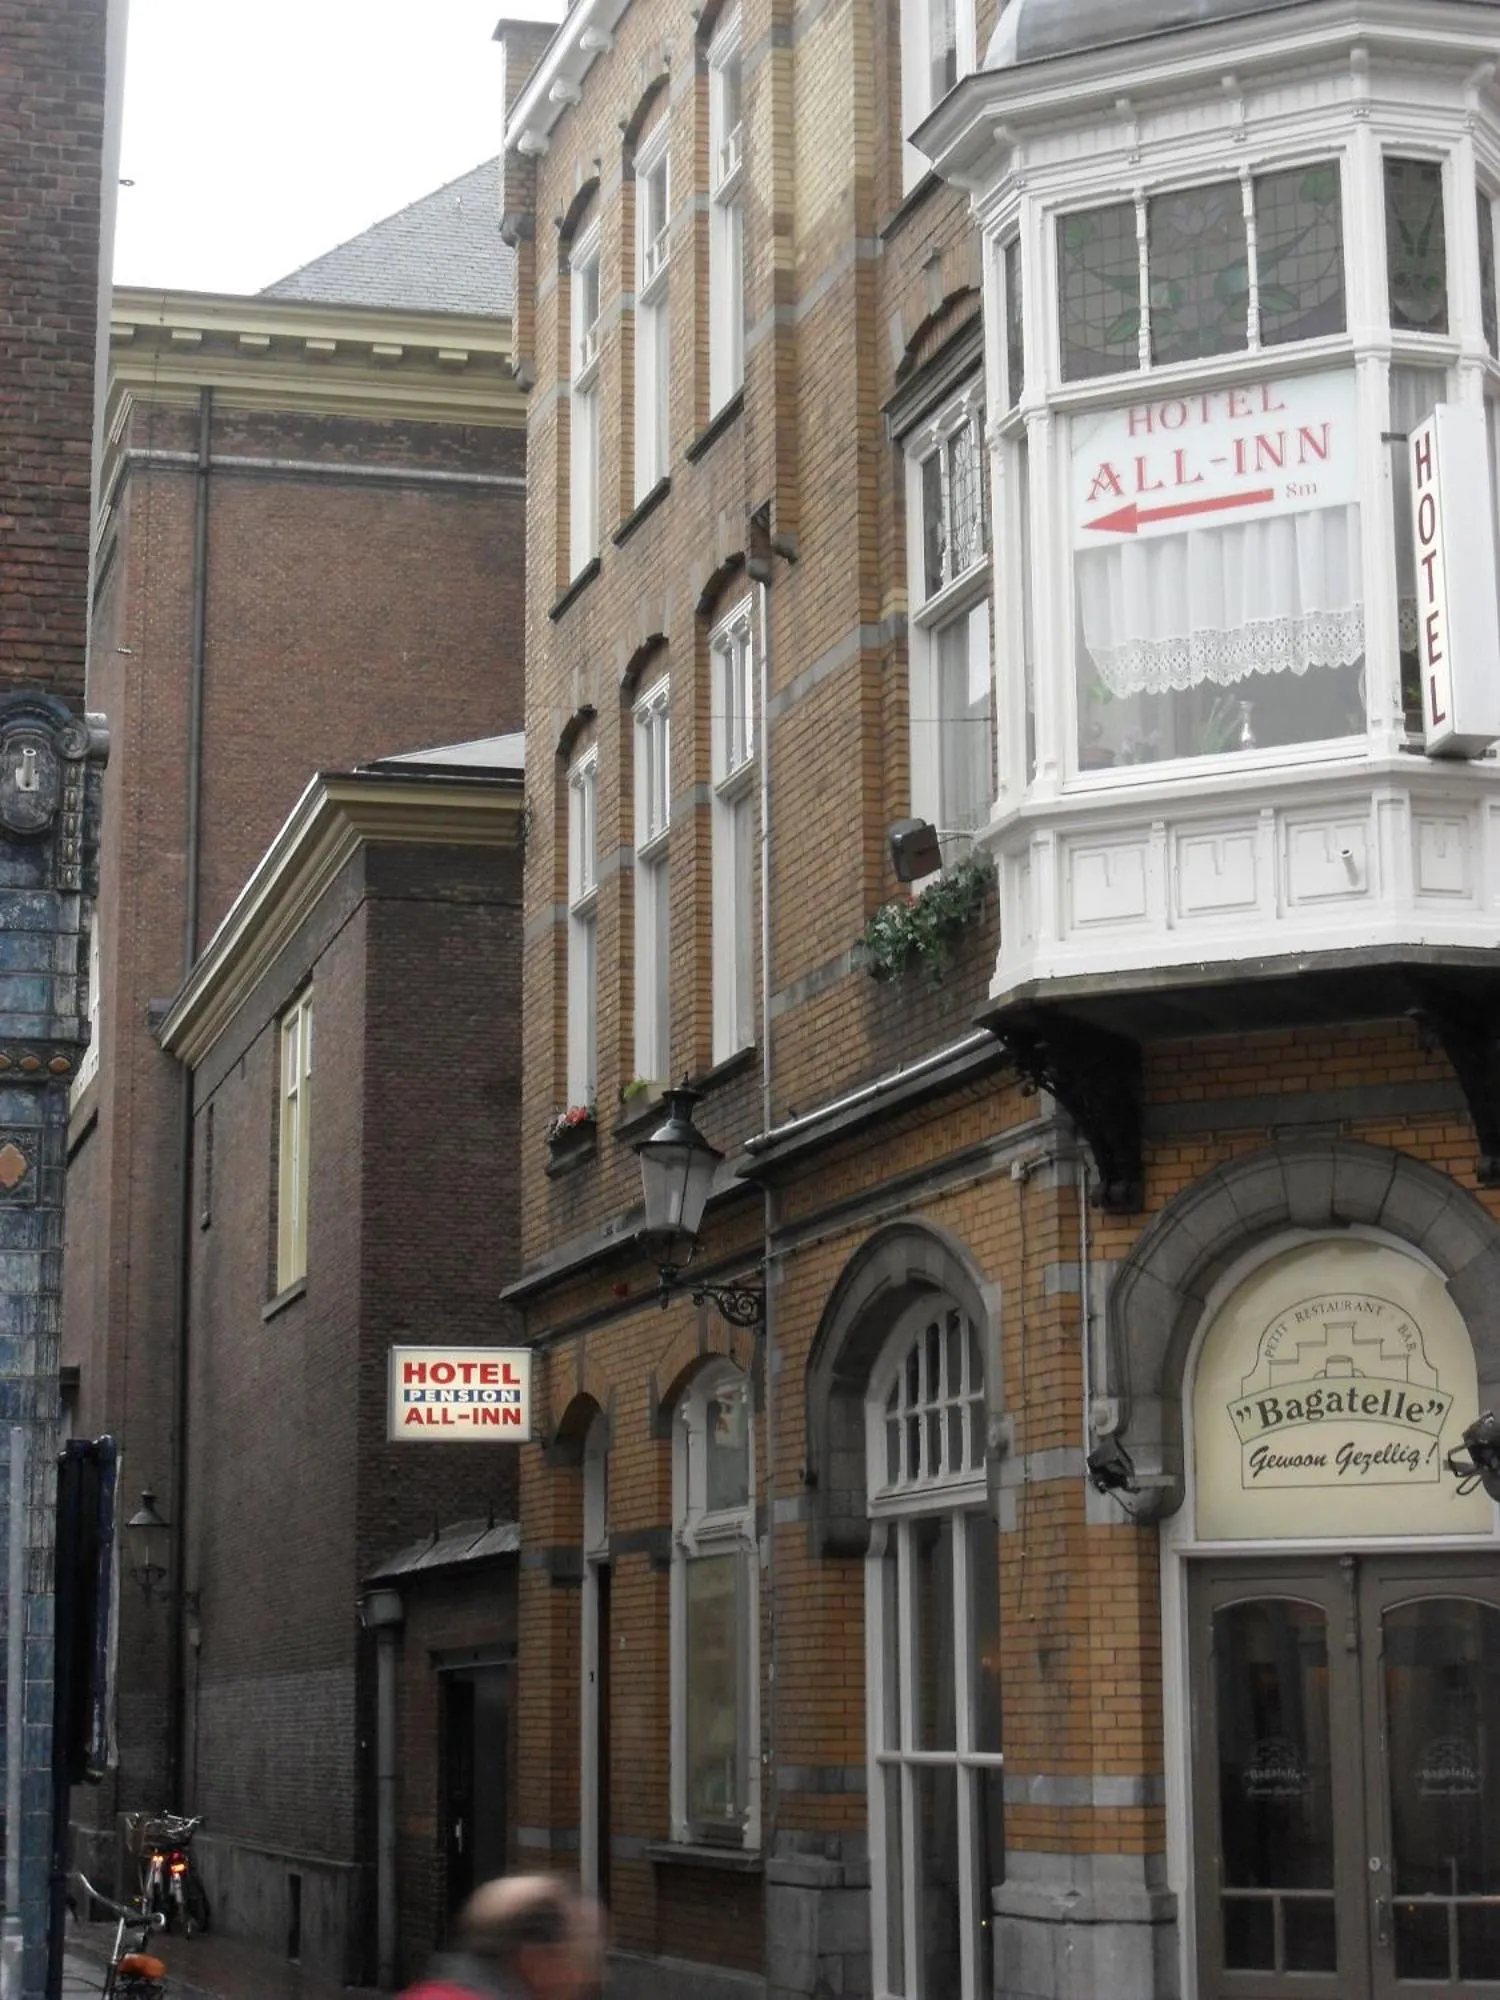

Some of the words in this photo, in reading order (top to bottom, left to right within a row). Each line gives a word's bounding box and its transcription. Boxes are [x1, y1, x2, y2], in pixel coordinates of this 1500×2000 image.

[1128, 382, 1287, 437] HOTEL
[1086, 422, 1331, 501] ALL-INN
[1414, 431, 1446, 726] HOTEL
[1264, 1320, 1289, 1358] PETIT
[1294, 1300, 1386, 1323] RESTAURANT
[403, 1362, 521, 1385] HOTEL
[409, 1389, 515, 1402] PENSION
[404, 1407, 521, 1425] ALL-INN
[1249, 1445, 1328, 1478] Gewoon
